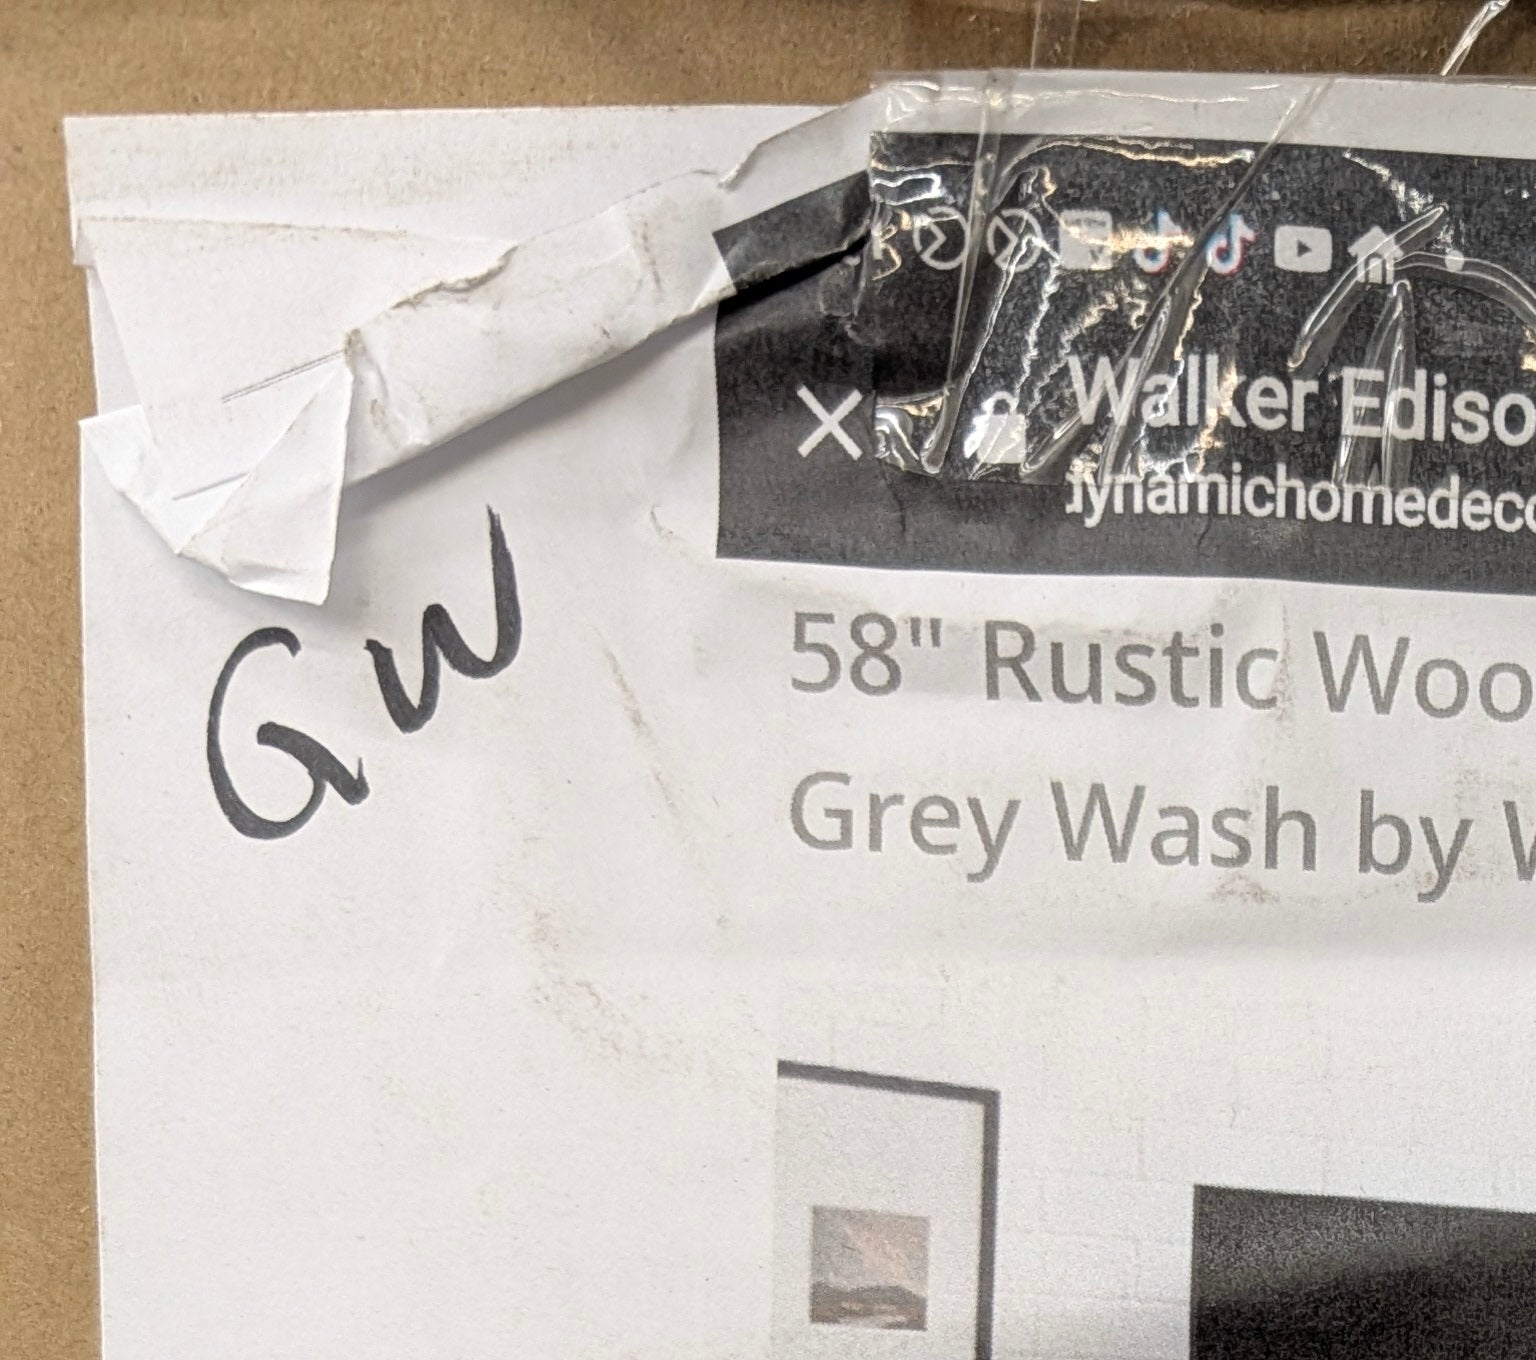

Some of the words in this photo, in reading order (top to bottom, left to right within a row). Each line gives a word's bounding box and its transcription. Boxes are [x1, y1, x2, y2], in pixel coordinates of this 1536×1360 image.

[1066, 354, 1319, 432] Walker
[207, 504, 521, 839] GW
[791, 612, 942, 695] 58"
[984, 620, 1279, 709] Rustic
[789, 772, 1021, 883] Grey
[1050, 781, 1317, 872] Wash
[1358, 789, 1474, 904] by
